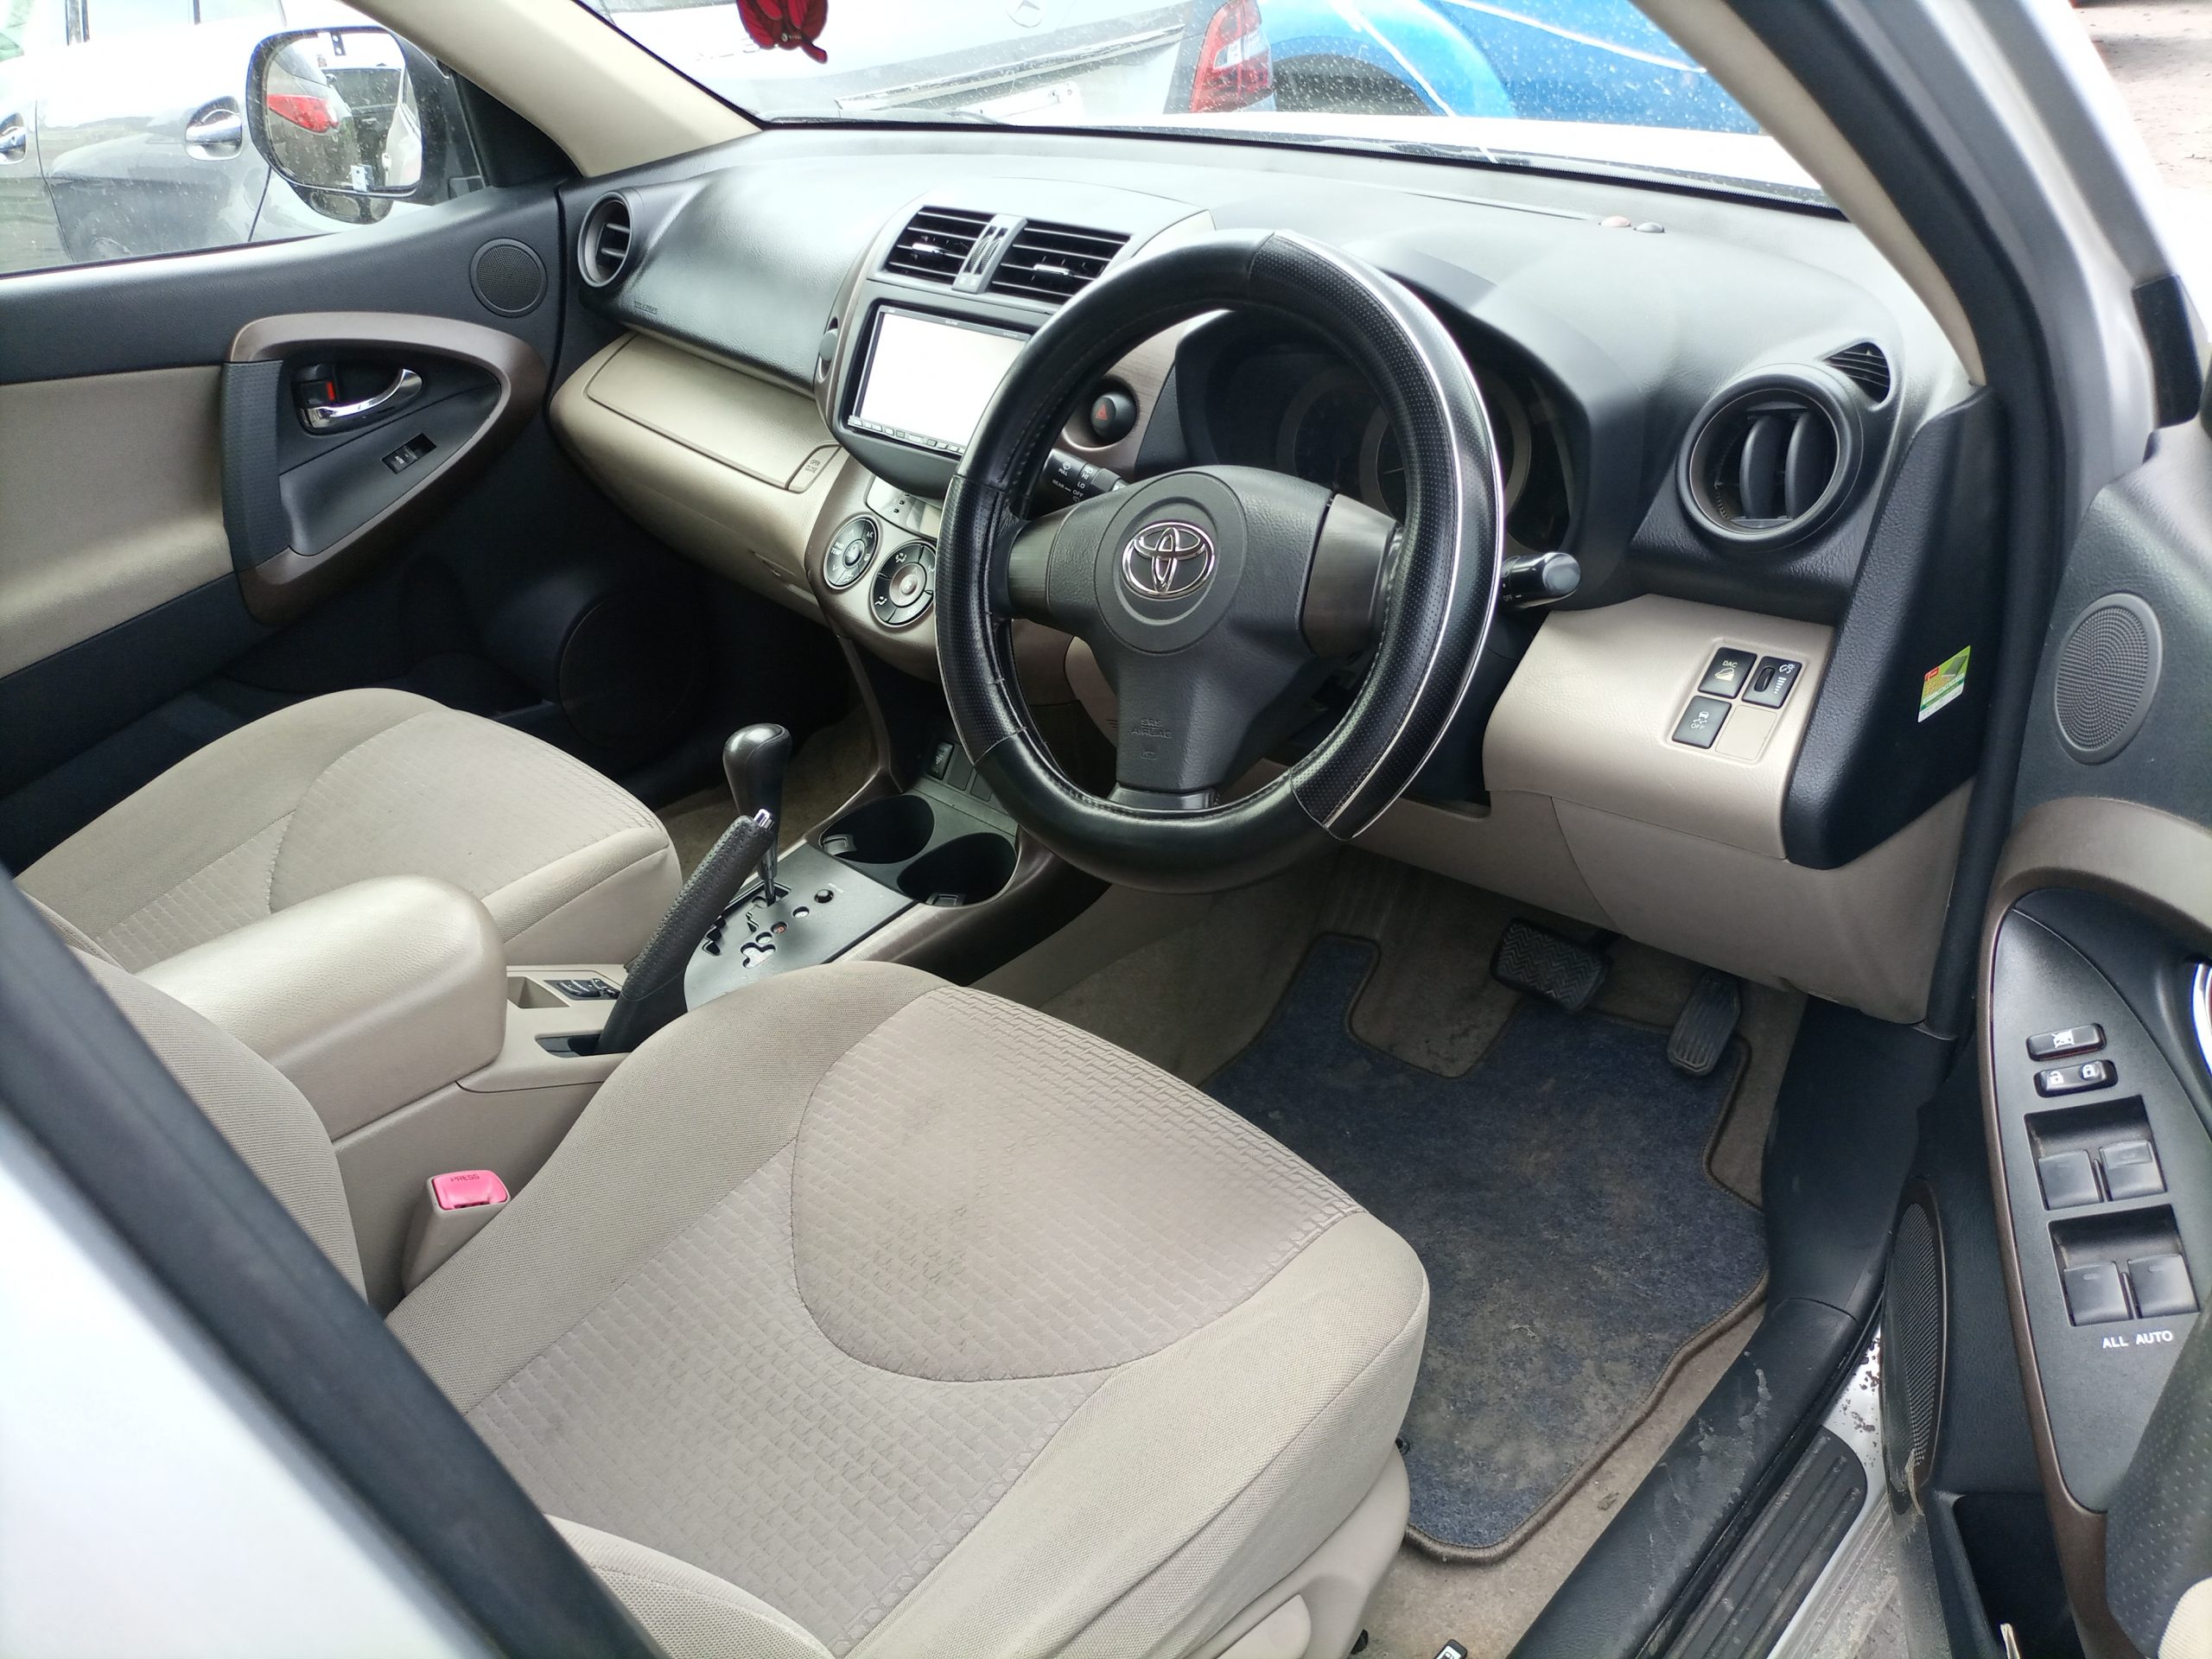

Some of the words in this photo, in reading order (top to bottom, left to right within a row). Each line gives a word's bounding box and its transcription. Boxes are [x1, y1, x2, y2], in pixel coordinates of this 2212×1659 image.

[1058, 467, 1068, 477] PULL
[1072, 489, 1084, 498] OFF
[1141, 717, 1162, 727] SRS
[2102, 1336, 2129, 1349] ALL
[2135, 1331, 2173, 1345] AUTO
